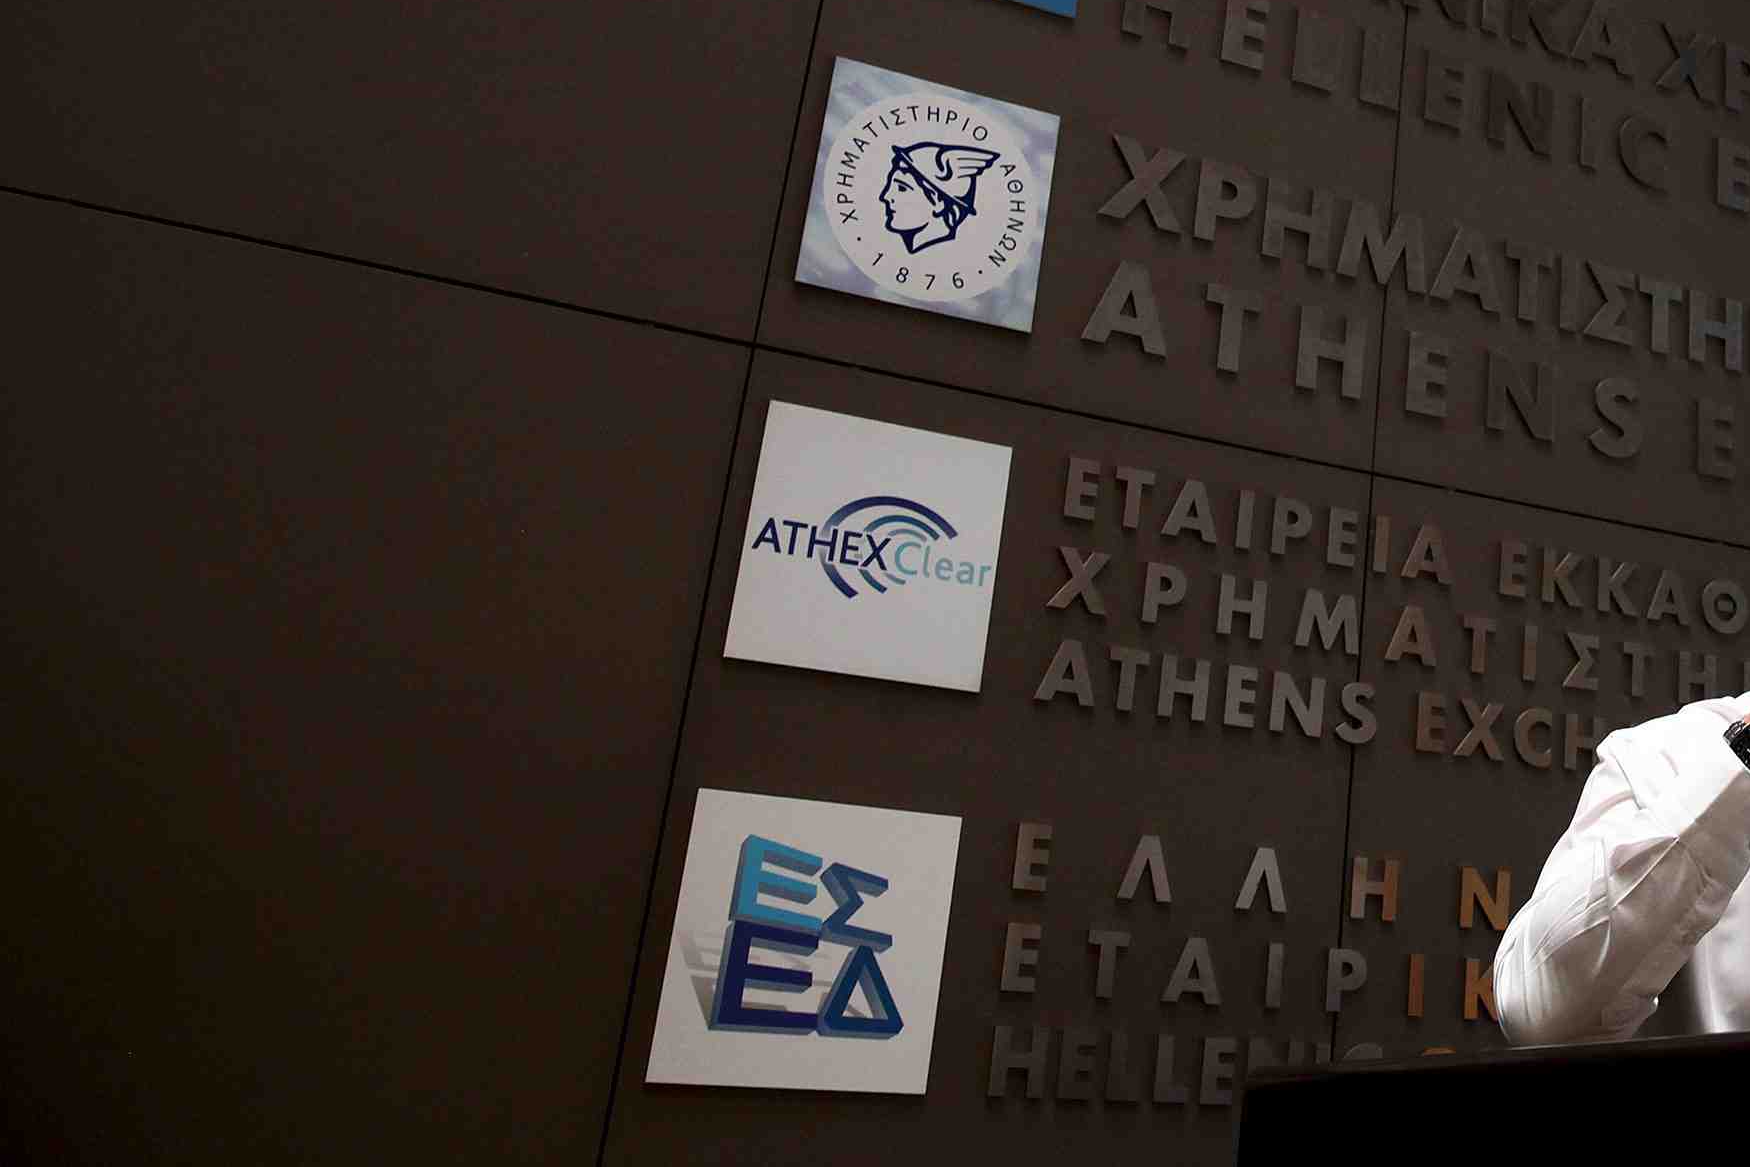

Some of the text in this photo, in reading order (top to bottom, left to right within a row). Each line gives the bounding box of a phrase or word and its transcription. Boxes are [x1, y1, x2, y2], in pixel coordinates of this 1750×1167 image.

[836, 105, 1026, 268] ΧΡΗΜΑΤΙΣΤΗΡΙΟ ΑΘΗΝΩΝ
[872, 252, 965, 291] 1876
[1079, 260, 1642, 460] ATHENS
[1061, 455, 1454, 588] ΕΤΑΙΡΕΙΑ
[1033, 638, 1378, 746] ATHENS
